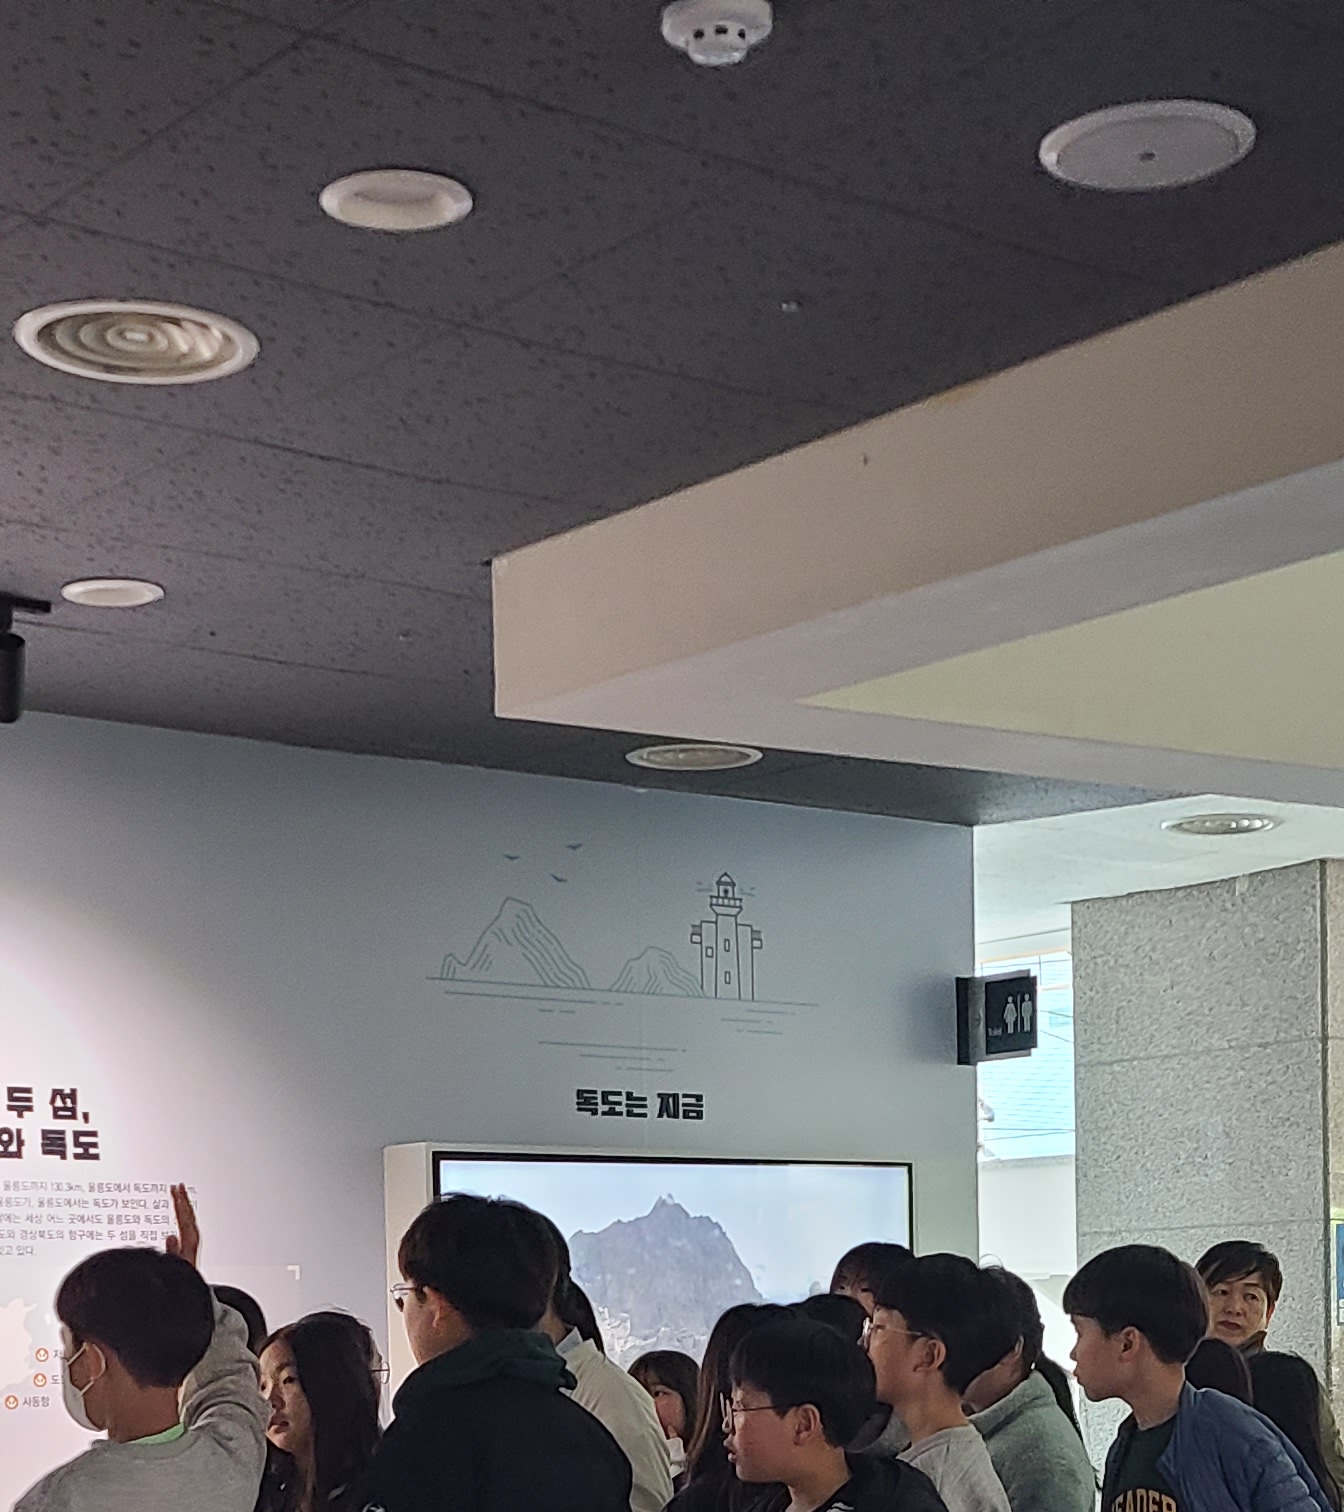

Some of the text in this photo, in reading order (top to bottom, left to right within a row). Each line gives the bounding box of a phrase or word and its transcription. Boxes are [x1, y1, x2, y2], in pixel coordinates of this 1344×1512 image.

[6, 1086, 34, 1119] 두
[49, 1087, 90, 1124] 섬,
[576, 1089, 704, 1120] 독도는 지금
[40, 1128, 100, 1160] 독도
[3, 1180, 48, 1192] 울릉도까지
[88, 1182, 130, 1193] 울릉도에서
[133, 1183, 168, 1194] 독도까지
[37, 1197, 90, 1208] 울릉도에서는
[92, 1199, 119, 1209] 독도가
[121, 1199, 150, 1210] 보인다.
[25, 1213, 43, 1224] 세상
[46, 1214, 65, 1224] 어느
[68, 1214, 104, 1225] 곳에서도
[106, 1214, 141, 1225] 울릉도와
[144, 1215, 170, 1225] 독도의
[19, 1229, 64, 1240] 경상북도의
[68, 1230, 104, 1241] 항구에는
[107, 1231, 116, 1241] 두
[140, 1231, 157, 1241] 직접
